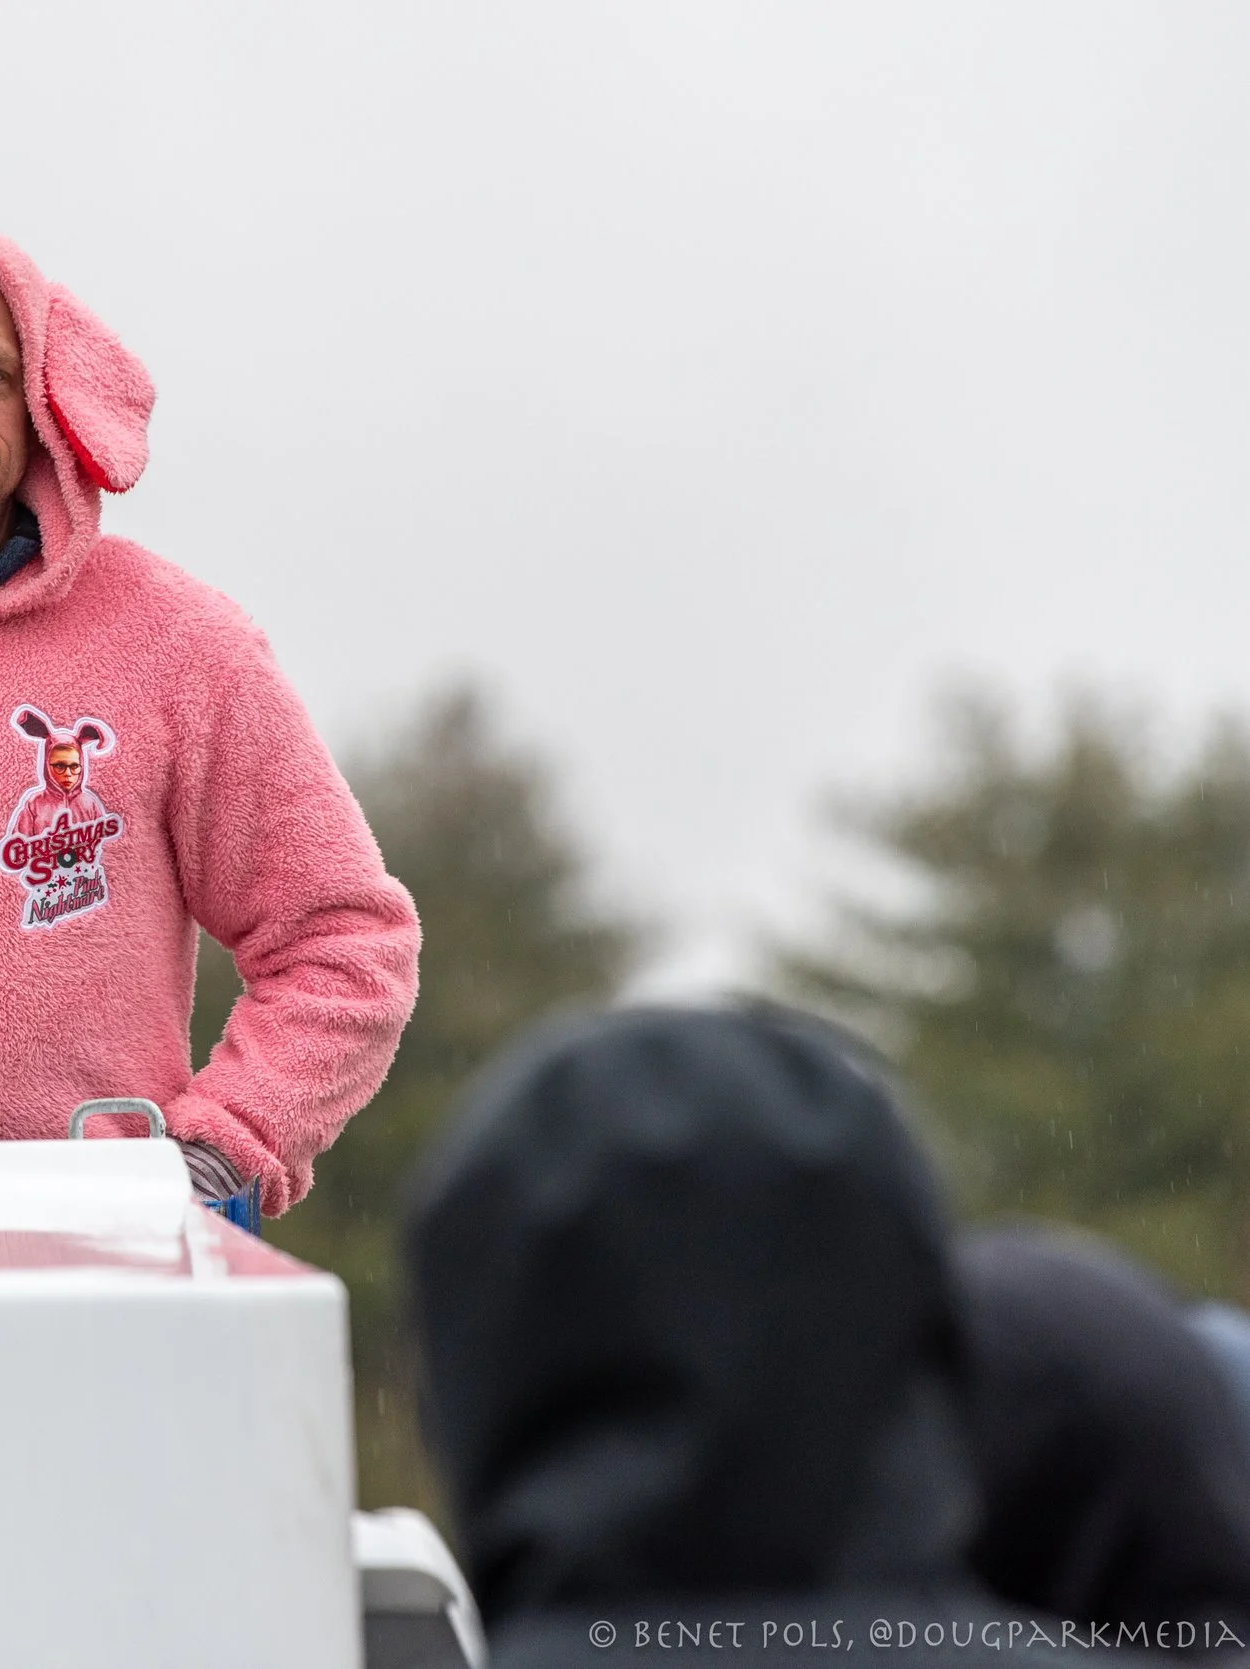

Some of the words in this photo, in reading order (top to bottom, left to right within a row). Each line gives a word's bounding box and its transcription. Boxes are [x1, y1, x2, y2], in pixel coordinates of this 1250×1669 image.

[49, 812, 70, 836] A
[2, 818, 119, 870] CHRISTMAS
[26, 840, 102, 885] STORY
[74, 871, 103, 897] Pink
[28, 887, 105, 925] Nightmare
